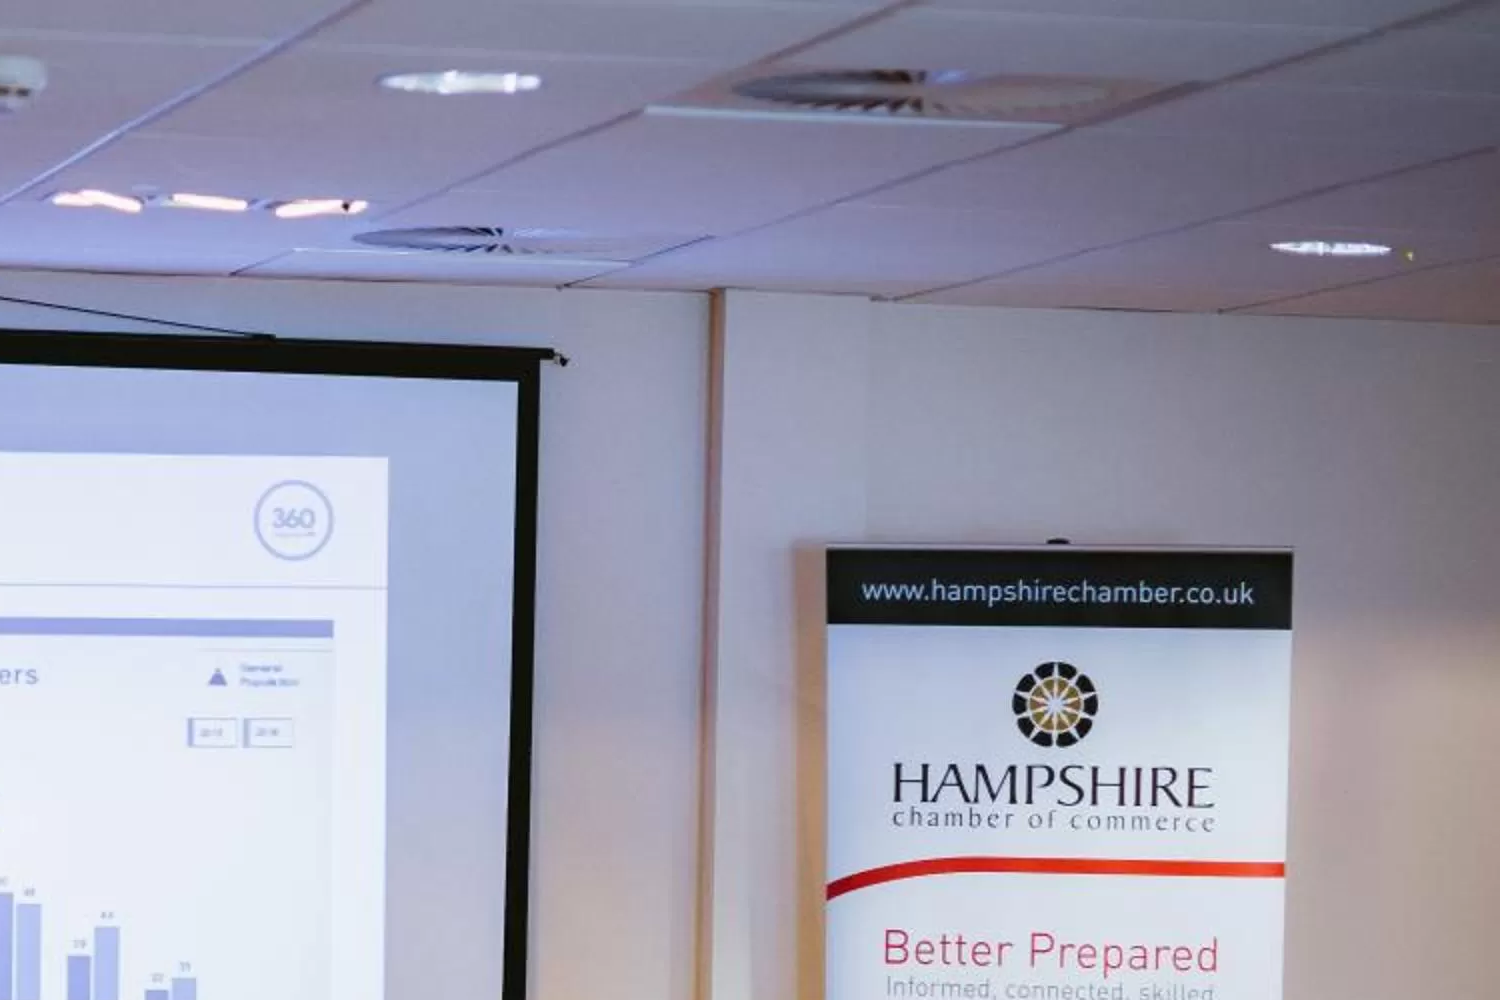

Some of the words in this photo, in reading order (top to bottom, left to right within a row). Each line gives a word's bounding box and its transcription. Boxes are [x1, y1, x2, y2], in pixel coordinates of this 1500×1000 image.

[271, 506, 317, 529] 360
[861, 577, 1255, 609] www.hampshirechamber.co.uk
[893, 762, 1216, 809] HAMPSHIRE
[892, 806, 1014, 830] chamber
[1028, 809, 1058, 831] of
[1071, 812, 1216, 833] commerce
[884, 928, 1015, 968] Better
[1029, 932, 1218, 979] Prepared
[886, 975, 997, 1000] Informed,
